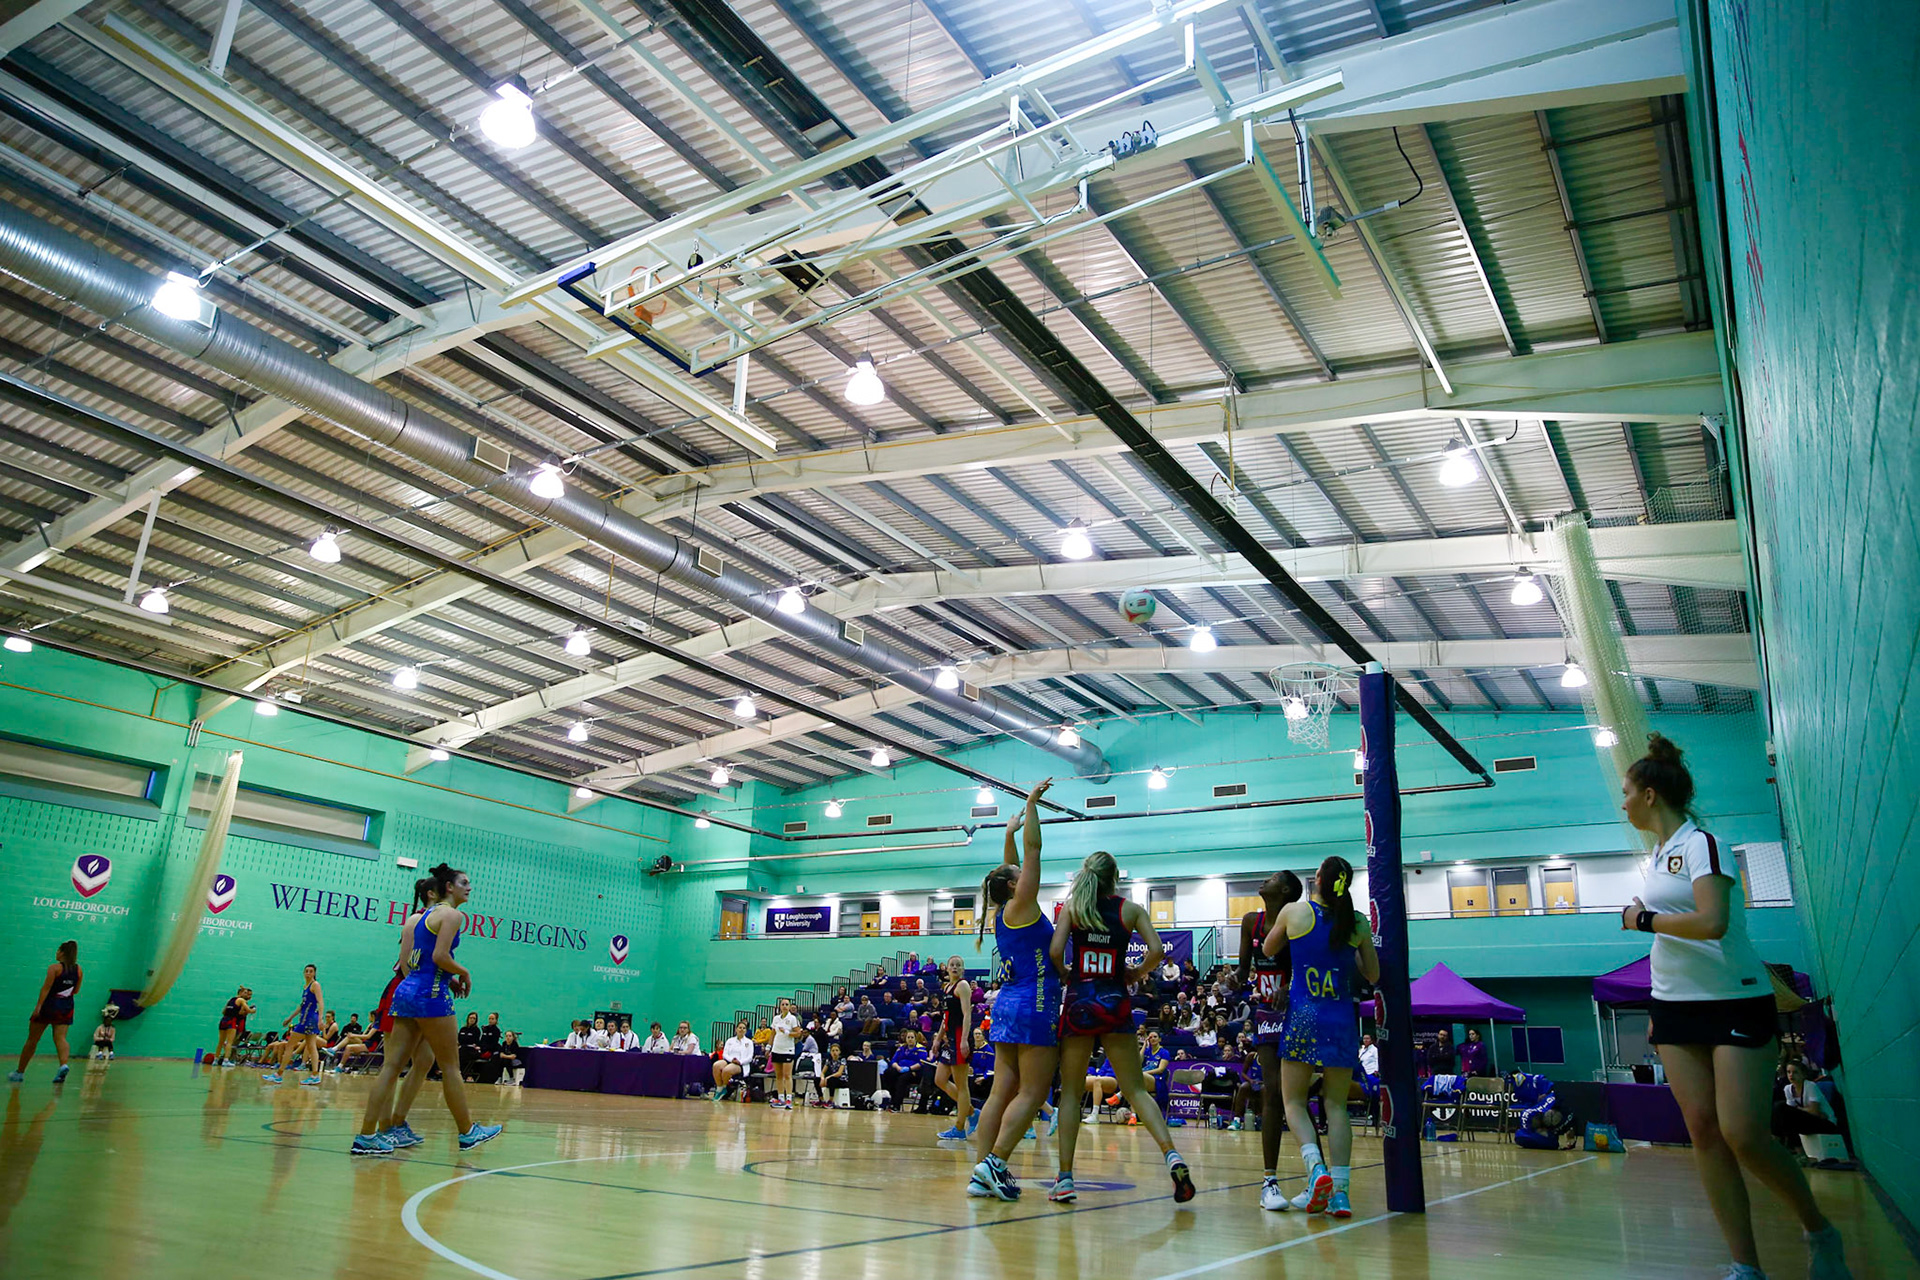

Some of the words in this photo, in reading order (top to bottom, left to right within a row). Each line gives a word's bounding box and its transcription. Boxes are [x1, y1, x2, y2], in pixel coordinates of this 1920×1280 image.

[32, 896, 130, 917] LOUGHBOROUGH
[52, 911, 109, 924] SPORT
[270, 882, 380, 923] WHERE
[385, 900, 504, 940] HORY
[509, 919, 588, 951] BEGINS
[786, 912, 823, 922] Loughborough
[786, 920, 812, 928] University
[198, 927, 235, 938] PORT
[1087, 932, 1111, 944] BRIGHT
[1305, 967, 1336, 998] GA
